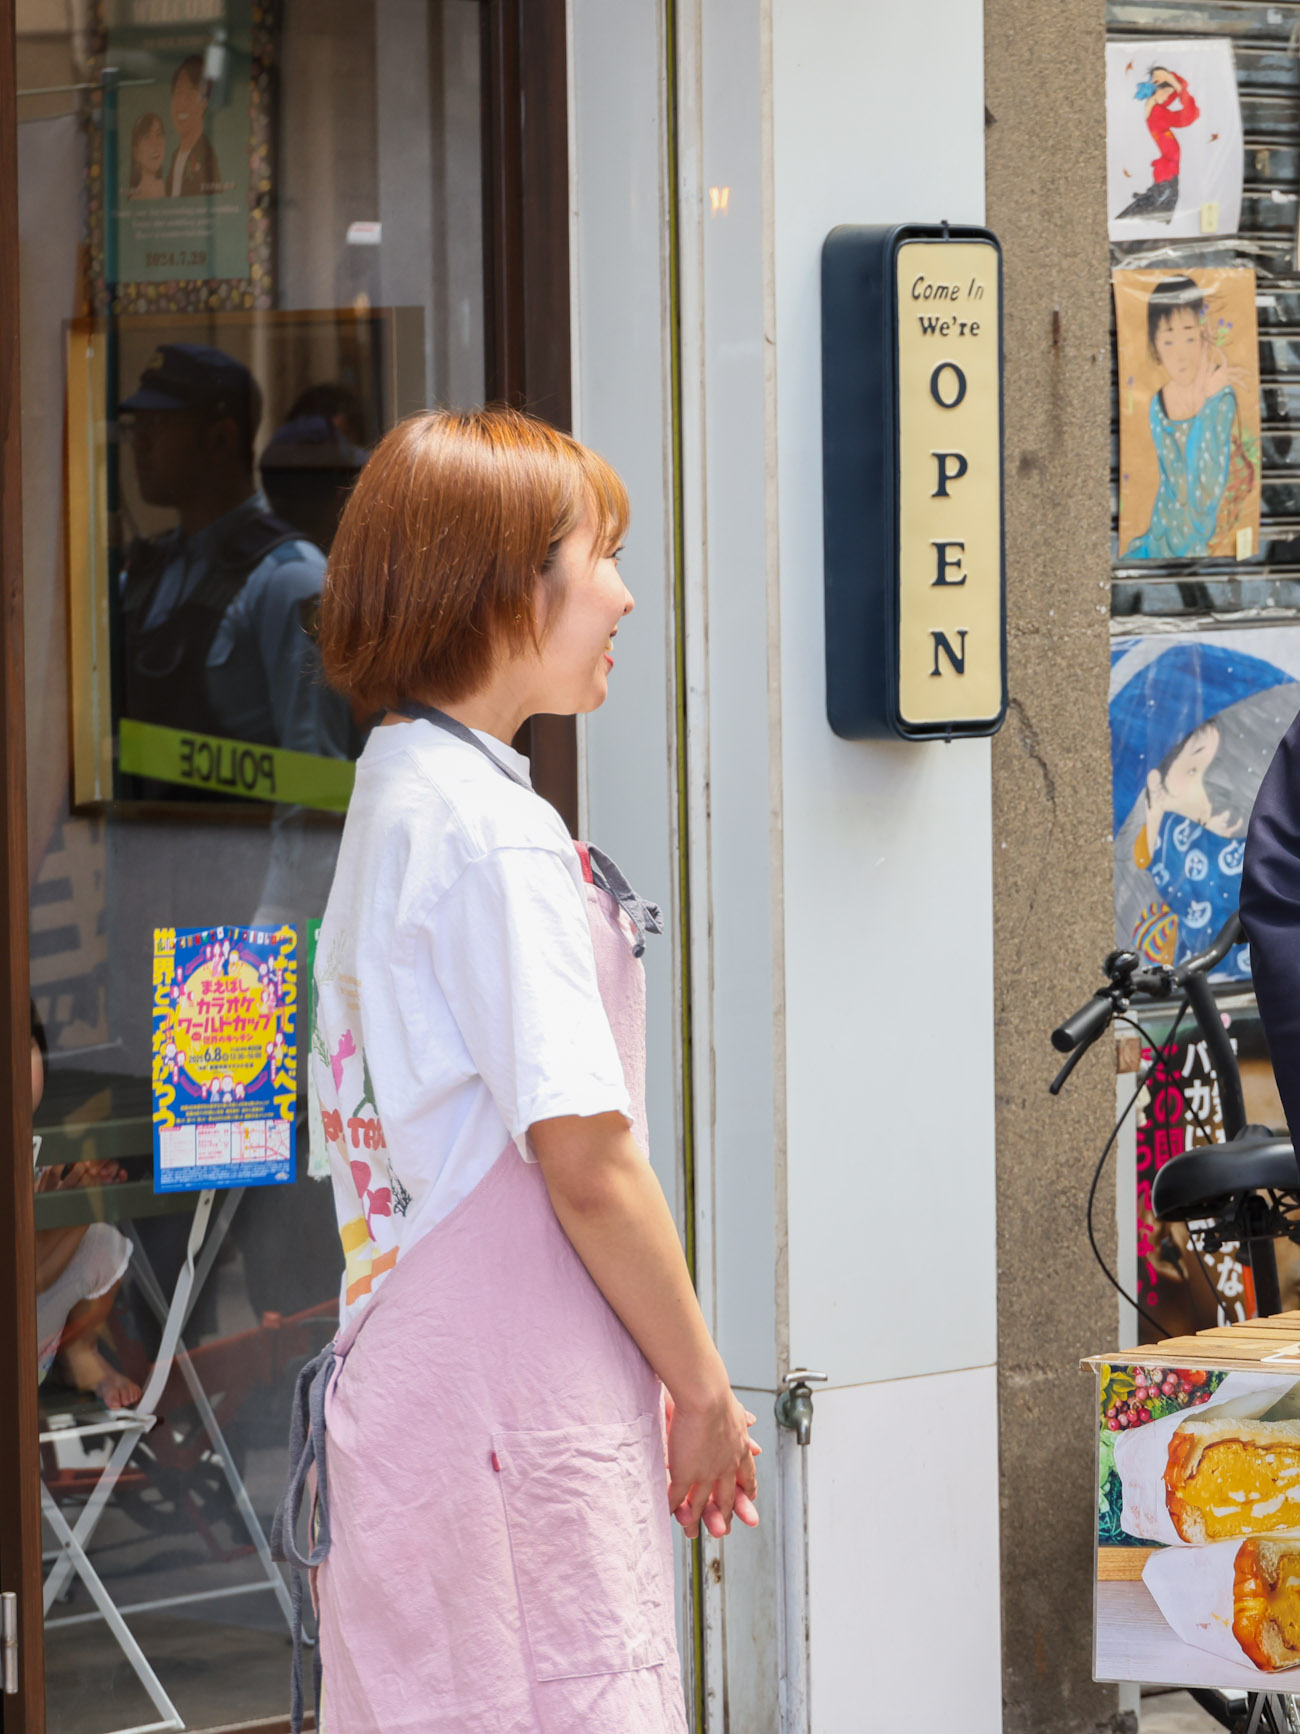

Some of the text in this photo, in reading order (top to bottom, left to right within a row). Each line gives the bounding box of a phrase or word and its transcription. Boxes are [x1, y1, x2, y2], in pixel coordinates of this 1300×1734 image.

[911, 275, 985, 302] Come In
[917, 315, 981, 338] We're
[929, 360, 969, 678] OPEN
[201, 978, 250, 996] まえばし
[196, 996, 256, 1015] カラオケ
[177, 1012, 274, 1035] ワールドカップ
[204, 1046, 222, 1063] 6.8
